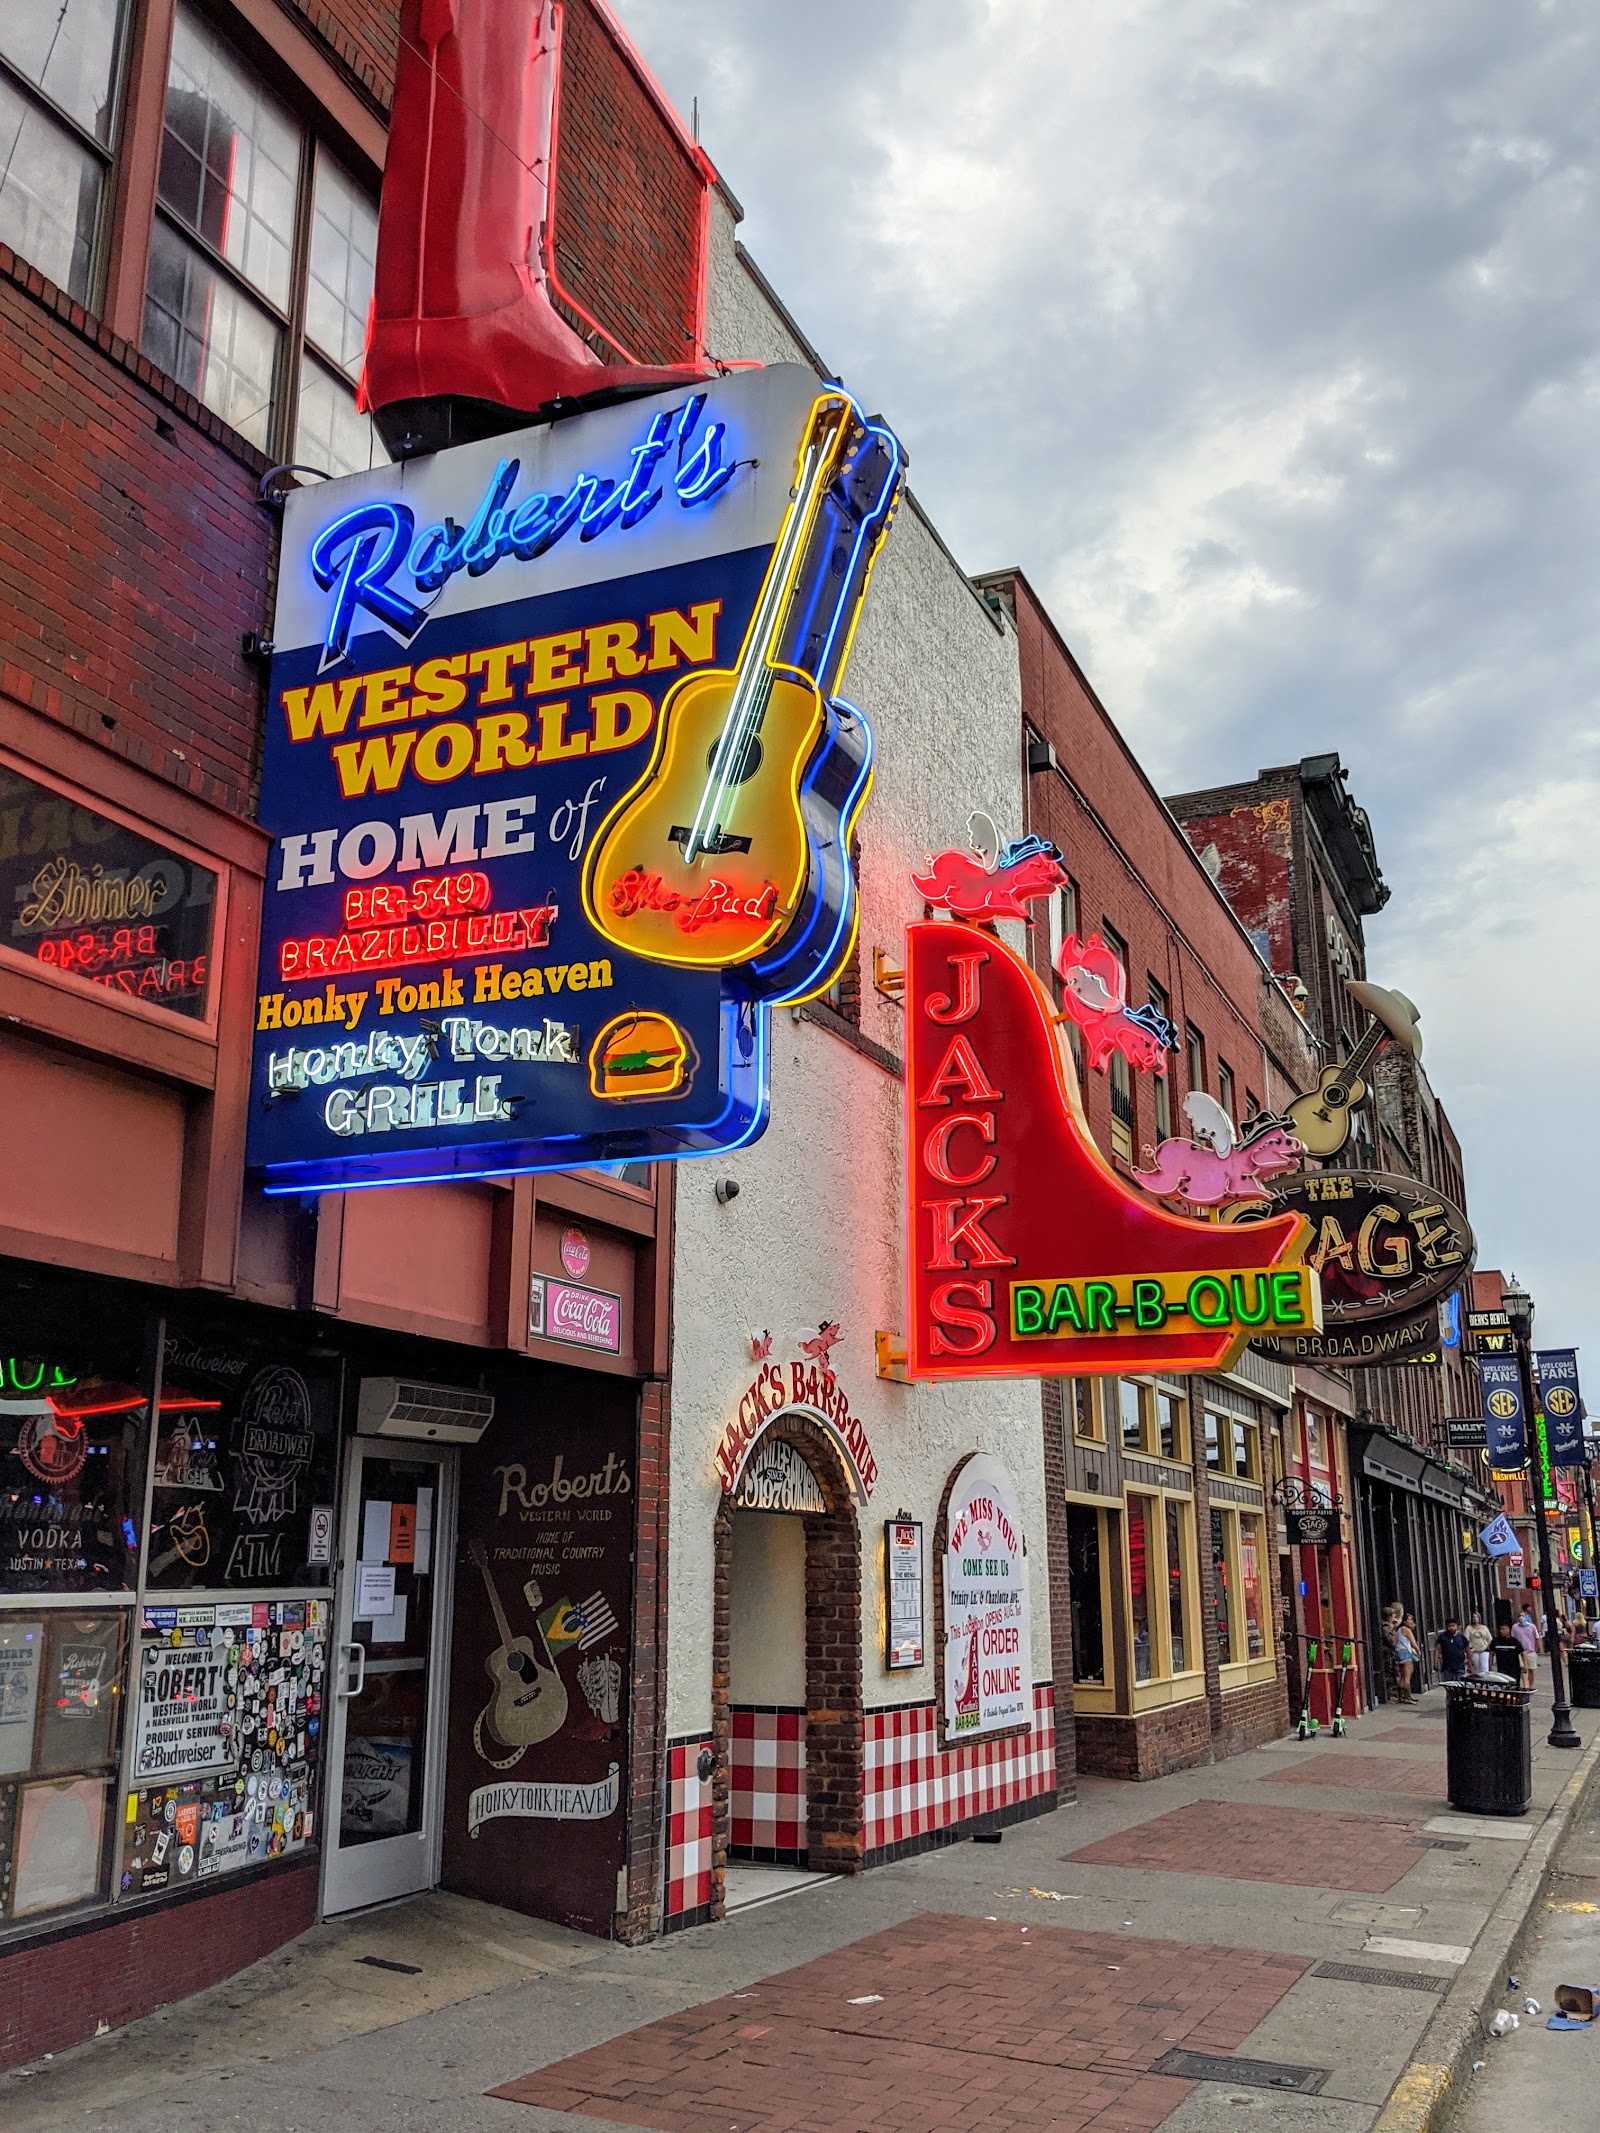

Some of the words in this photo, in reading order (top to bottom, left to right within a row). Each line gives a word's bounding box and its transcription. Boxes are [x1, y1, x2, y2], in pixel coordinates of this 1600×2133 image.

[310, 394, 734, 674] Robert's
[282, 599, 722, 743] WESTERN
[332, 689, 656, 798] WORLD
[277, 795, 537, 891] HOME
[549, 776, 607, 861] of
[20, 856, 167, 927] Shiner
[344, 871, 491, 930] BR-549
[280, 904, 559, 982] BRAZILBILLY
[257, 985, 369, 1031] Honky
[375, 968, 466, 1015] Tonk
[473, 957, 613, 1004] Heaven
[269, 1029, 438, 1096] Honky
[441, 1017, 581, 1063] Tonk
[325, 1075, 512, 1136] GRILL
[917, 951, 1016, 1357] JACKS
[1305, 1177, 1354, 1201] THE
[1220, 1200, 1465, 1278] AGE
[570, 1293, 589, 1301] DRINK
[1014, 1270, 1305, 1337] BAR-B-QUE
[1469, 1314, 1489, 1326] DIERKS
[1489, 1313, 1510, 1325] BENTLE
[553, 1326, 577, 1337] DELICIOUS
[577, 1331, 587, 1340] AND
[588, 1332, 613, 1346] REFRESHING
[1296, 1320, 1429, 1356] BROADWAY
[1485, 1336, 1505, 1350] W
[164, 1339, 248, 1375] Budweiser
[1539, 1361, 1574, 1369] WELCOME
[1484, 1370, 1519, 1382] FANS
[1541, 1367, 1576, 1379] FANS
[1492, 1392, 1516, 1416] SEC
[1549, 1389, 1574, 1413] SEC
[714, 1363, 786, 1493] JACK'S
[492, 1453, 631, 1517] Robert's
[766, 1469, 784, 1480] SINCE
[1492, 1470, 1526, 1480] NASHVILLE
[757, 1475, 791, 1510] 1976
[519, 1510, 571, 1522] WESTERN
[576, 1509, 612, 1521] WORLD
[951, 1517, 968, 1553] WE
[968, 1498, 993, 1524] MISS
[996, 1506, 1018, 1559] YOU!
[1298, 1520, 1328, 1530] STAGE
[18, 1528, 82, 1549] VODKA
[535, 1532, 559, 1544] HOME
[562, 1531, 576, 1543] OF
[224, 1533, 286, 1579] ATM
[493, 1547, 555, 1560] TRADITIONAL
[562, 1547, 606, 1559] COUNTRY
[531, 1563, 561, 1575] MUSIC
[963, 1559, 982, 1576] COME
[985, 1559, 998, 1576] SEE
[1000, 1559, 1009, 1576] Us
[951, 1590, 968, 1608] Trinity
[979, 1590, 984, 1604] &
[985, 1590, 1008, 1604] Charlotte
[1009, 1589, 1020, 1604] Ave.
[950, 1624, 960, 1640] This
[985, 1608, 1002, 1628] OPENS
[982, 1628, 1019, 1656] ORDER
[165, 1652, 204, 1665] WELCOME
[205, 1651, 213, 1662] TO
[971, 1637, 979, 1699] JACK
[144, 1664, 233, 1703] ROBERT'S
[982, 1666, 1020, 1697] ONLINE
[152, 1701, 189, 1717] WESTERN
[191, 1698, 217, 1713] WORLD
[145, 1720, 150, 1728] A
[152, 1715, 189, 1727] NASHVILLE
[145, 1729, 183, 1744] PROUDLY
[155, 1742, 216, 1768] Budweiser
[352, 1764, 400, 1780] LIGHT
[554, 1781, 613, 1814] HEAVEN
